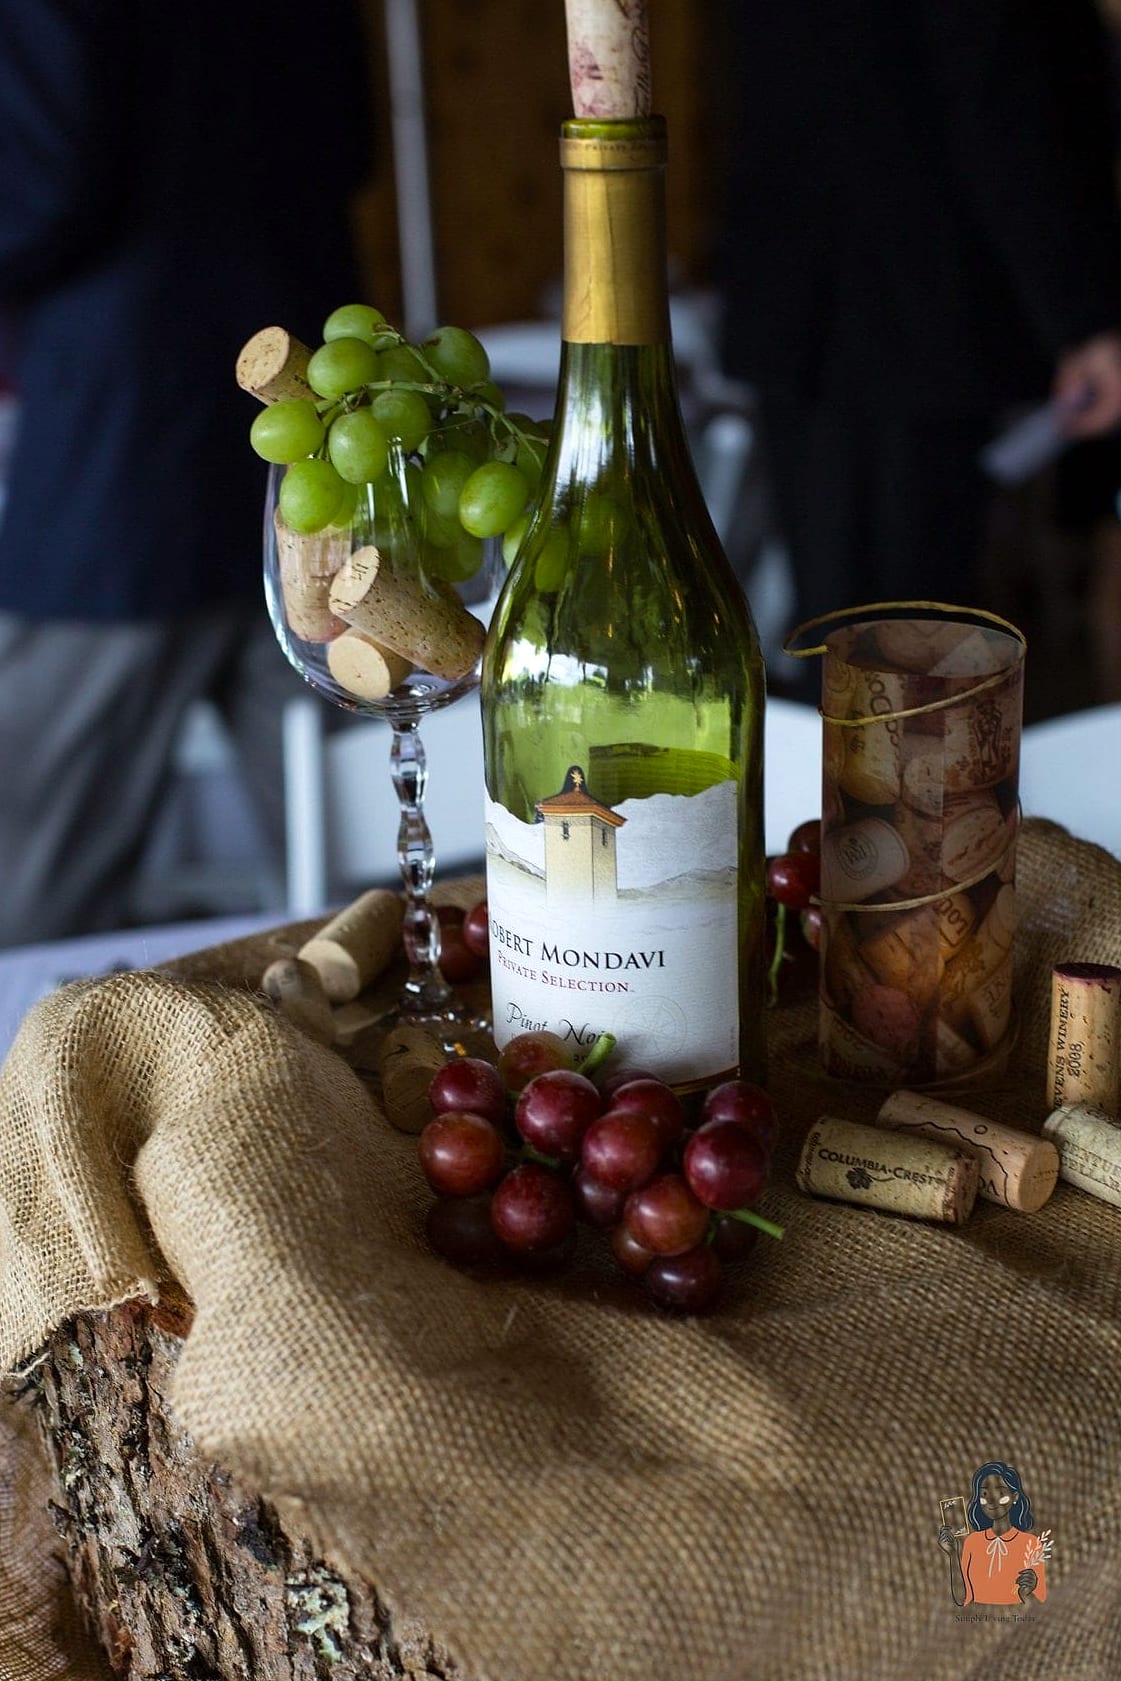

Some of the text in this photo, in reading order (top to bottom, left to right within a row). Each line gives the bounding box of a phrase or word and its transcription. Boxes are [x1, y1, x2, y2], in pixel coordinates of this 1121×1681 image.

[491, 919, 666, 969] OBERT MONDAVI
[497, 949, 629, 992] PRIVATE SELECTION
[505, 1001, 604, 1045] Pinot Noi
[1053, 988, 1069, 1108] EVENS WINERY
[1067, 1042, 1082, 1078] 2008
